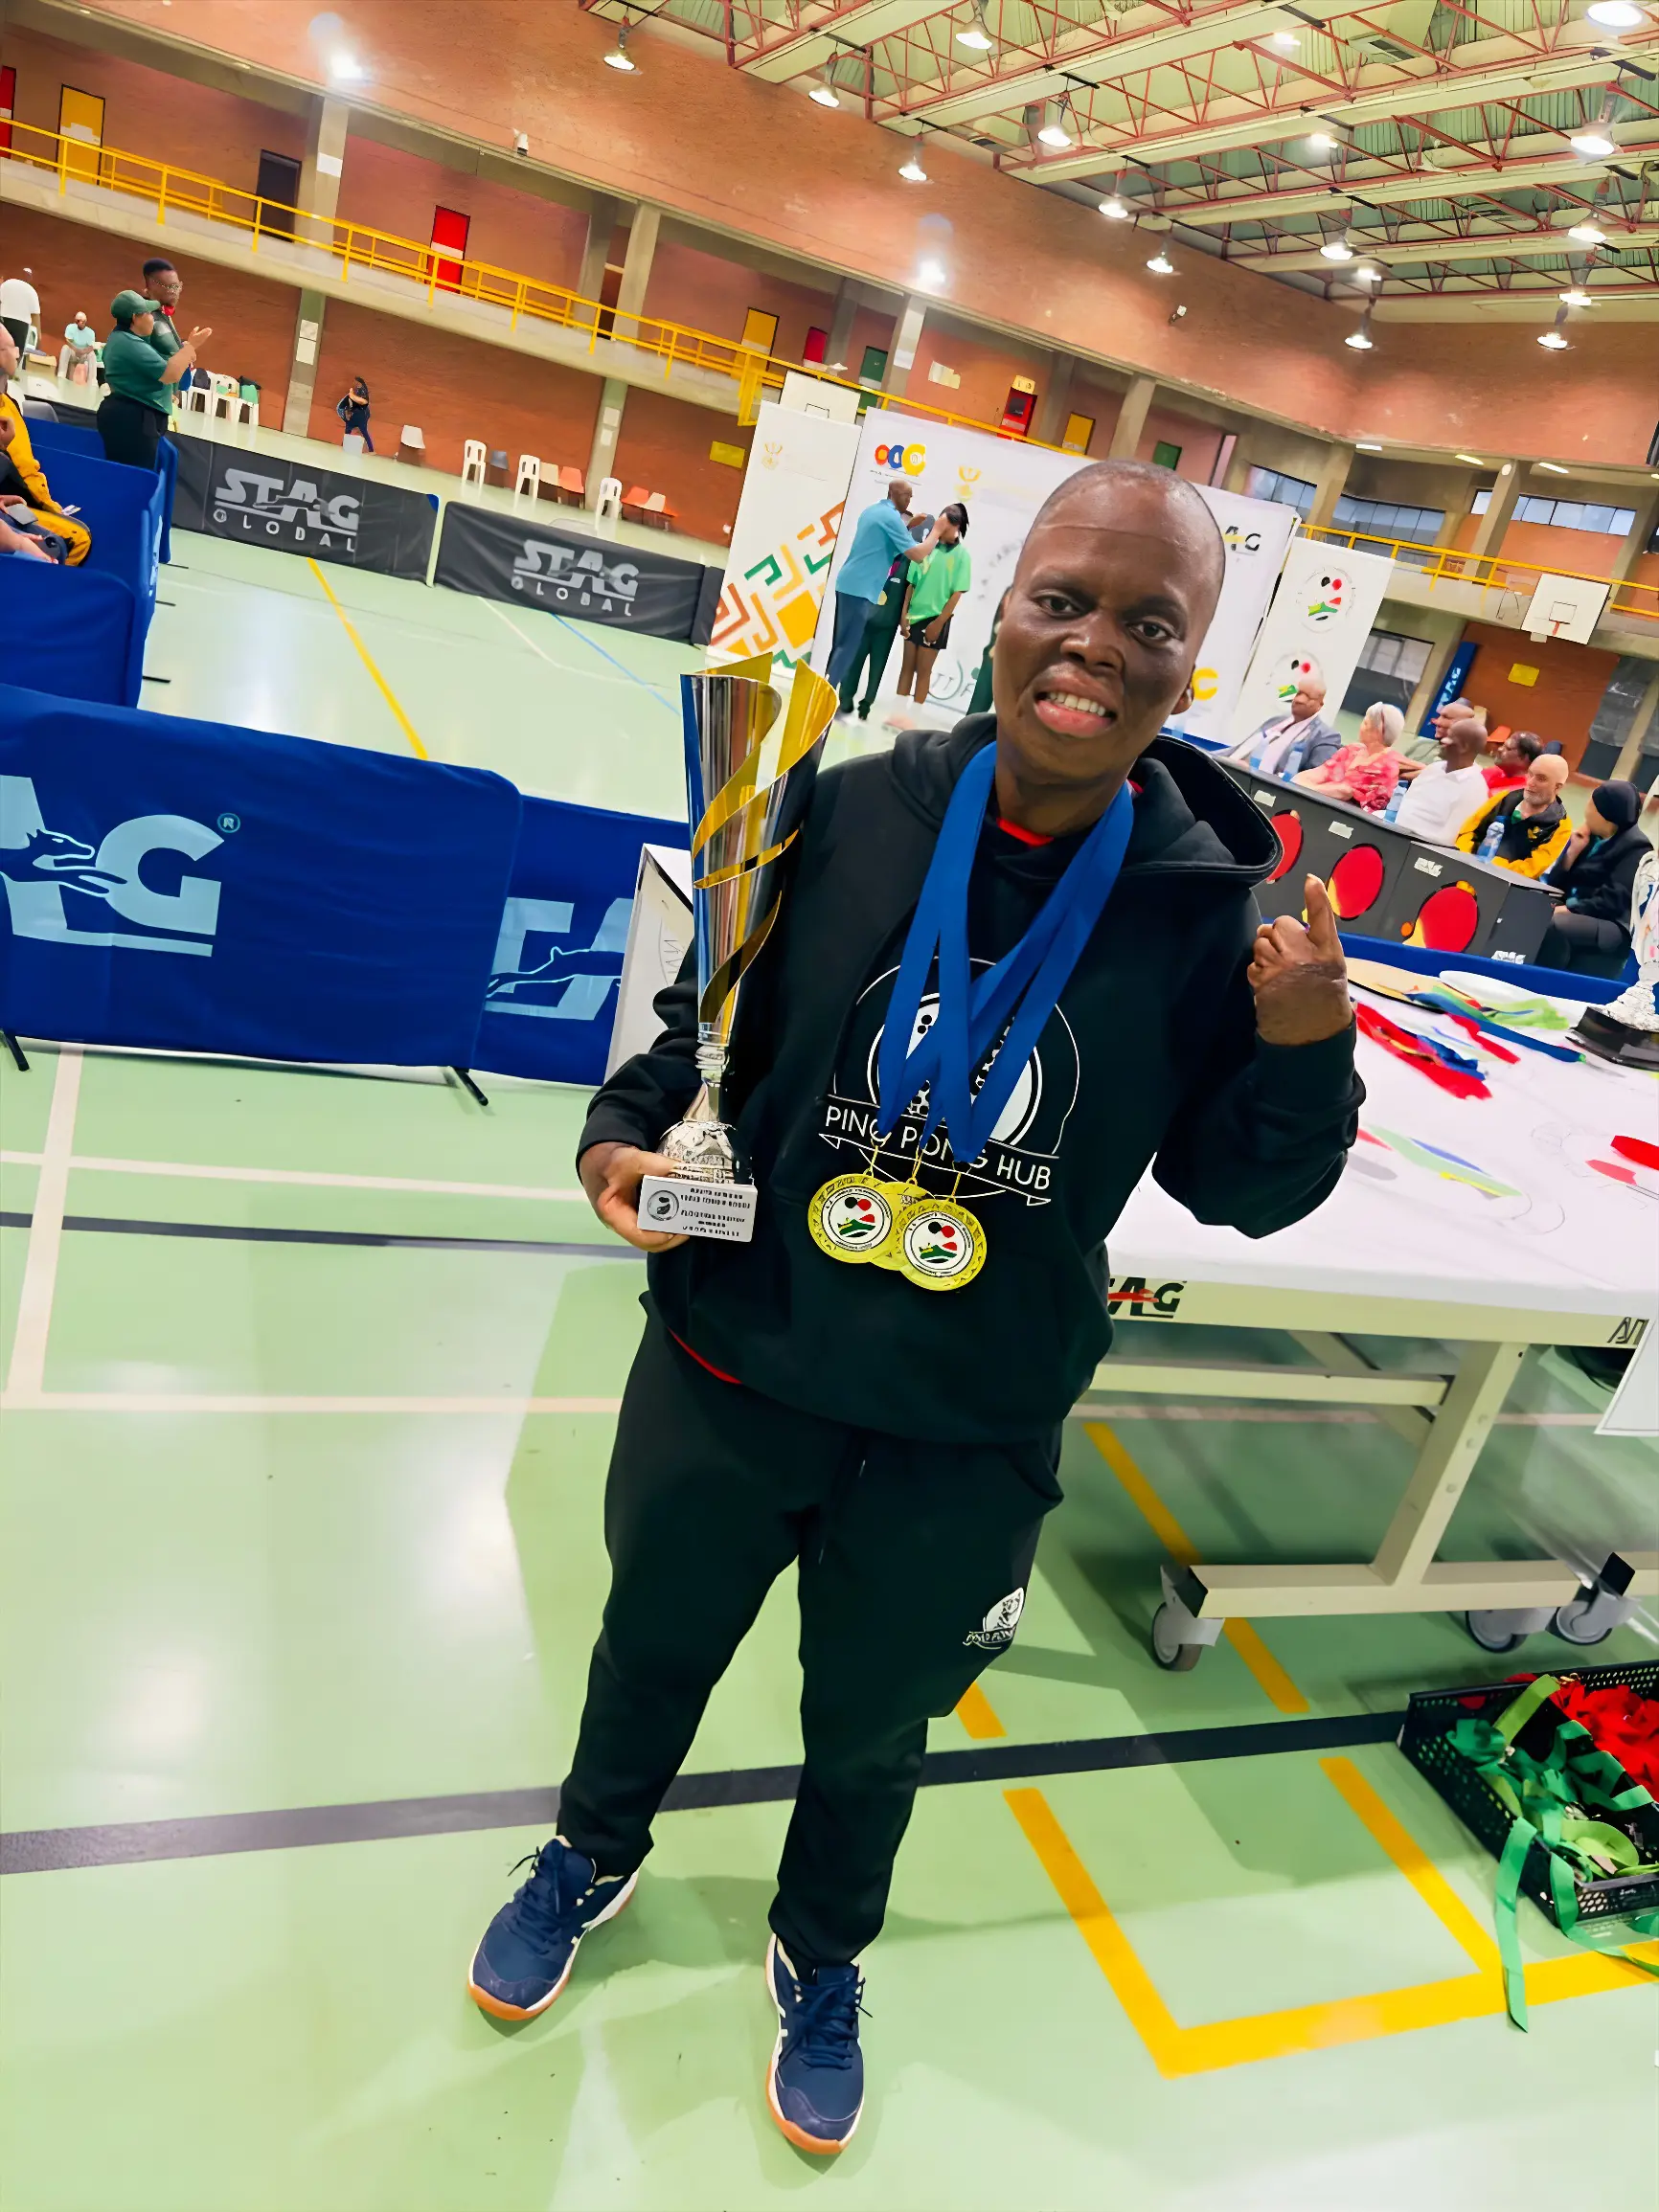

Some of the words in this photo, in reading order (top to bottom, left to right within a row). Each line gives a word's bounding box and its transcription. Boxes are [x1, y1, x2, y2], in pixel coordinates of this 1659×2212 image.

[215, 468, 360, 536] STAG
[513, 539, 639, 601] STAG
[996, 1154, 1051, 1190] HUB
[1107, 1276, 1186, 1319] AG
